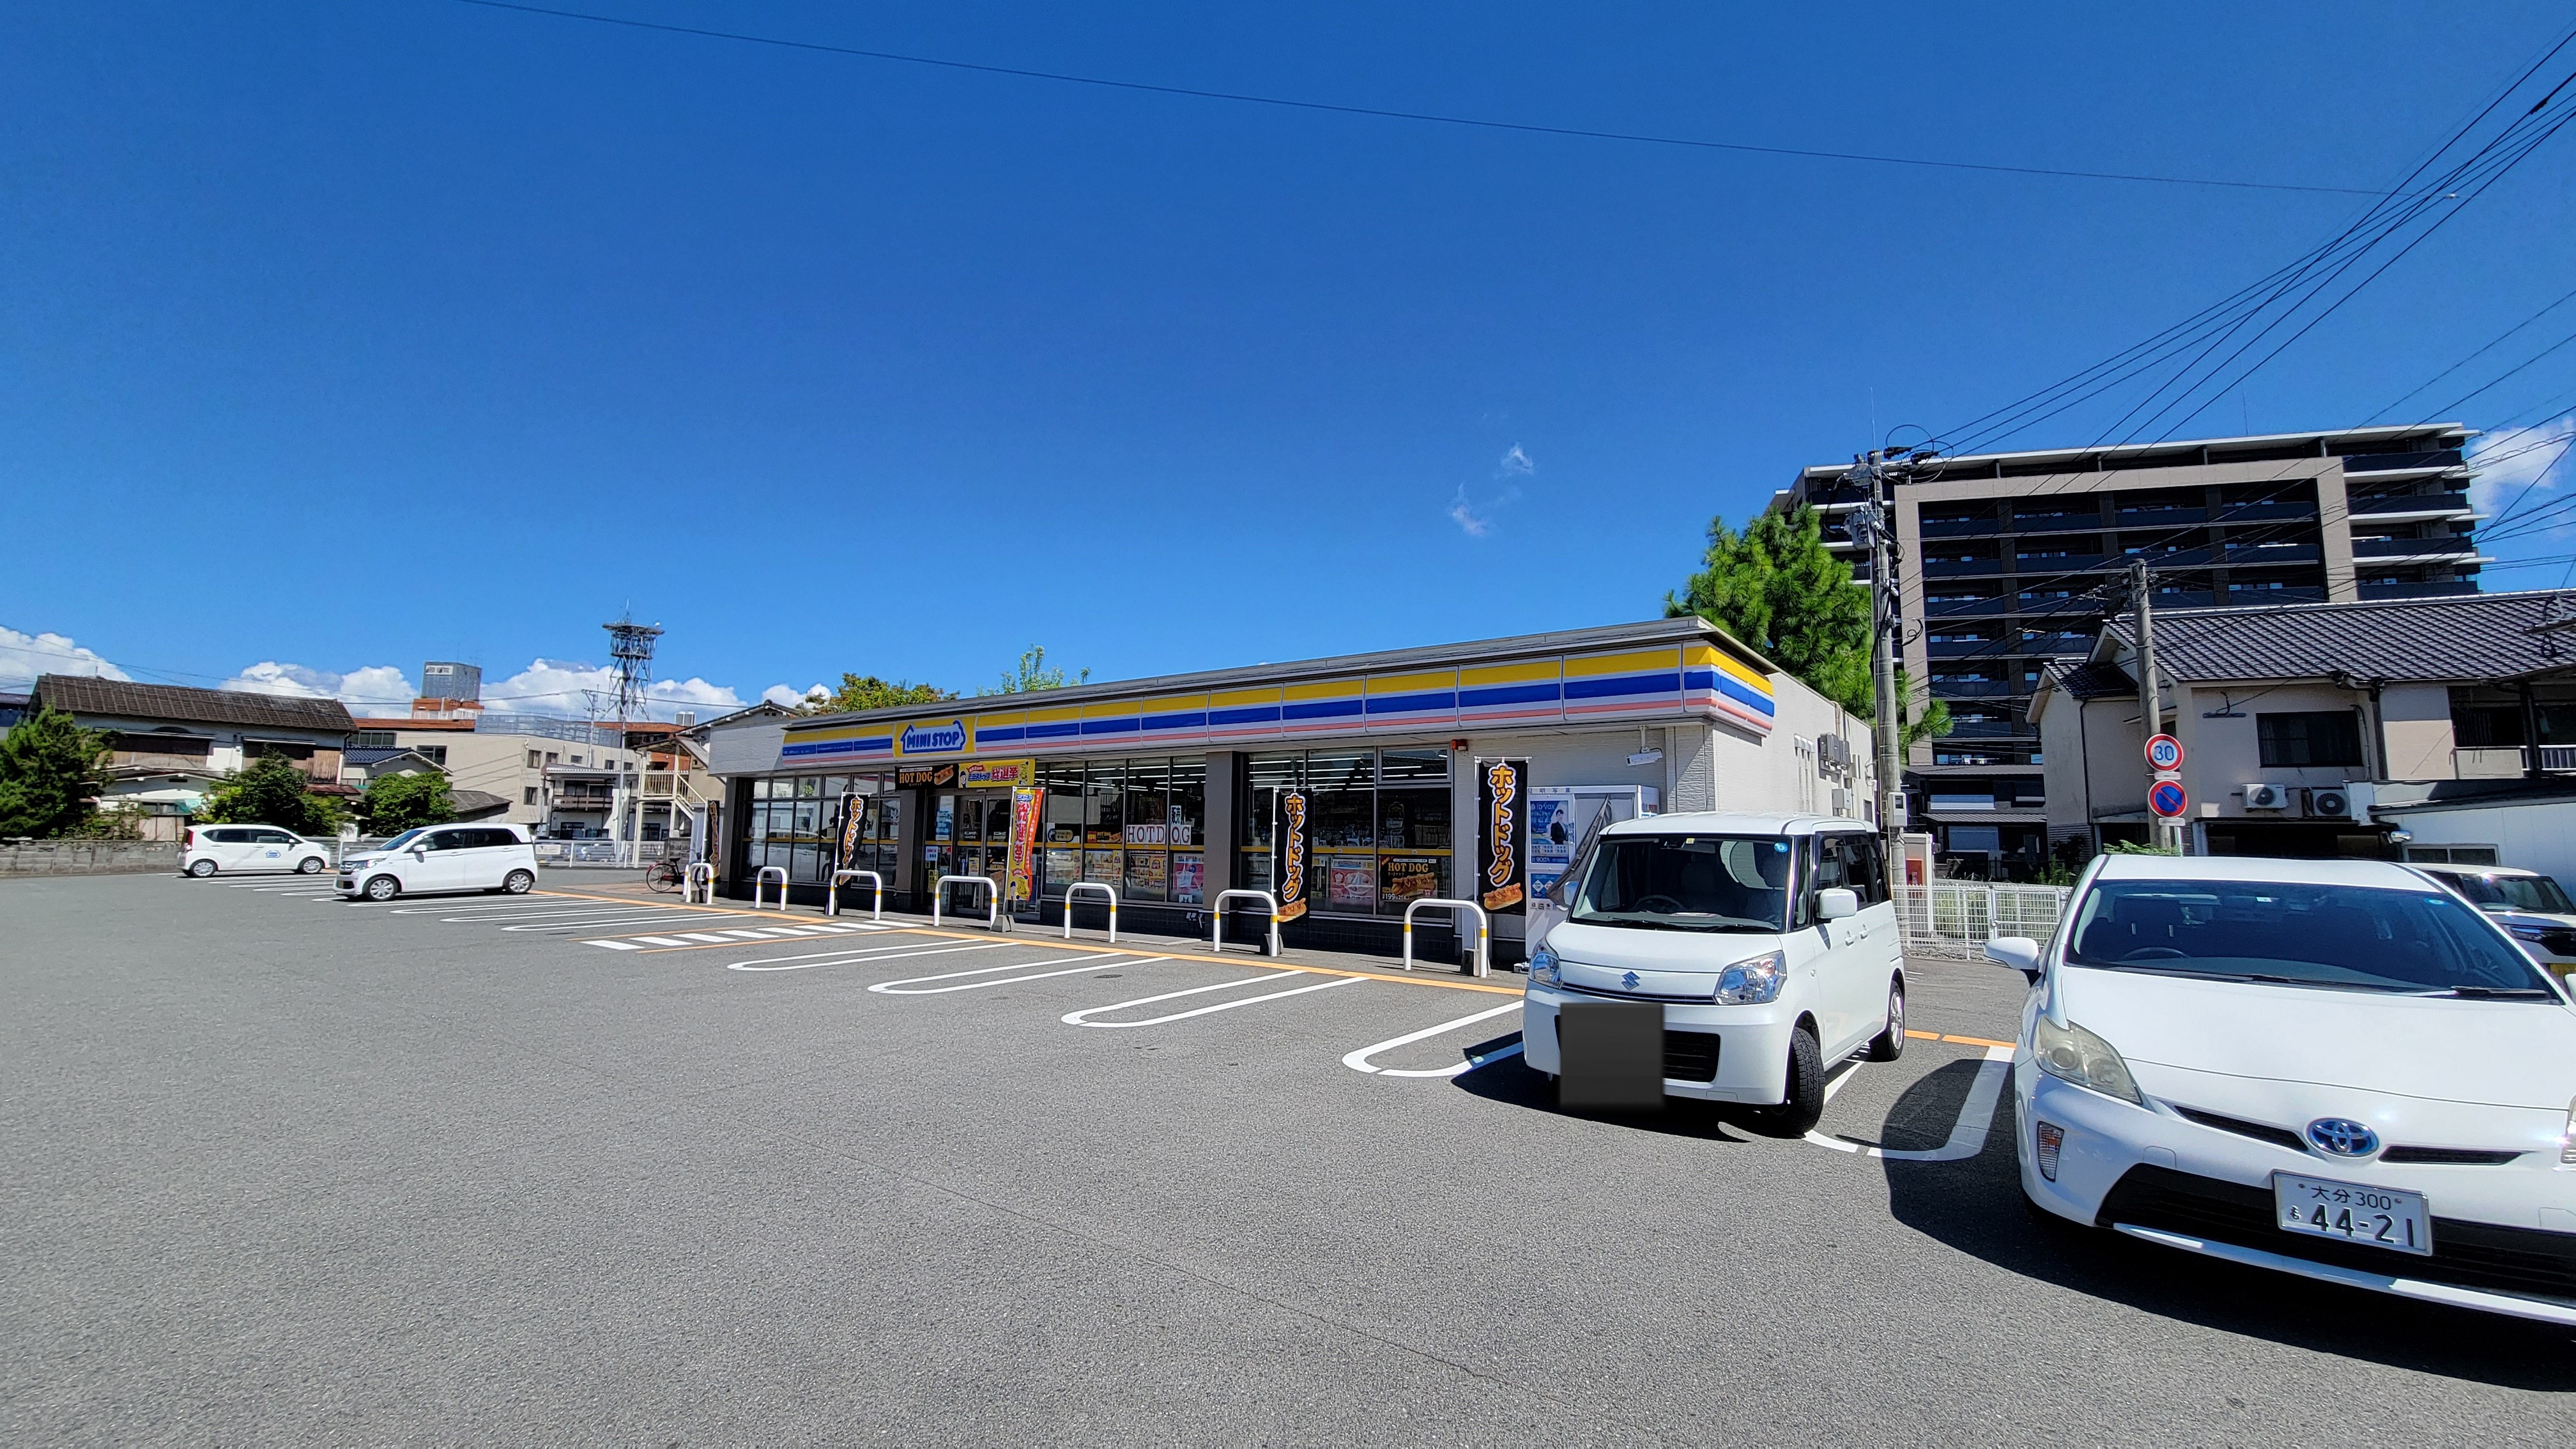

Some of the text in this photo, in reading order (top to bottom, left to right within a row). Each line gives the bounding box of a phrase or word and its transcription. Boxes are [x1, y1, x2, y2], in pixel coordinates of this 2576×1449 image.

[907, 732, 960, 748] MINI STOP
[2154, 745, 2175, 761] 30
[900, 772, 933, 783] HOT DOG
[1490, 765, 1514, 885] ホットドッグ
[1284, 794, 1305, 900] ホットドッグ
[1388, 862, 1429, 872] HOT DOG
[2311, 1203, 2414, 1247] 44-21
